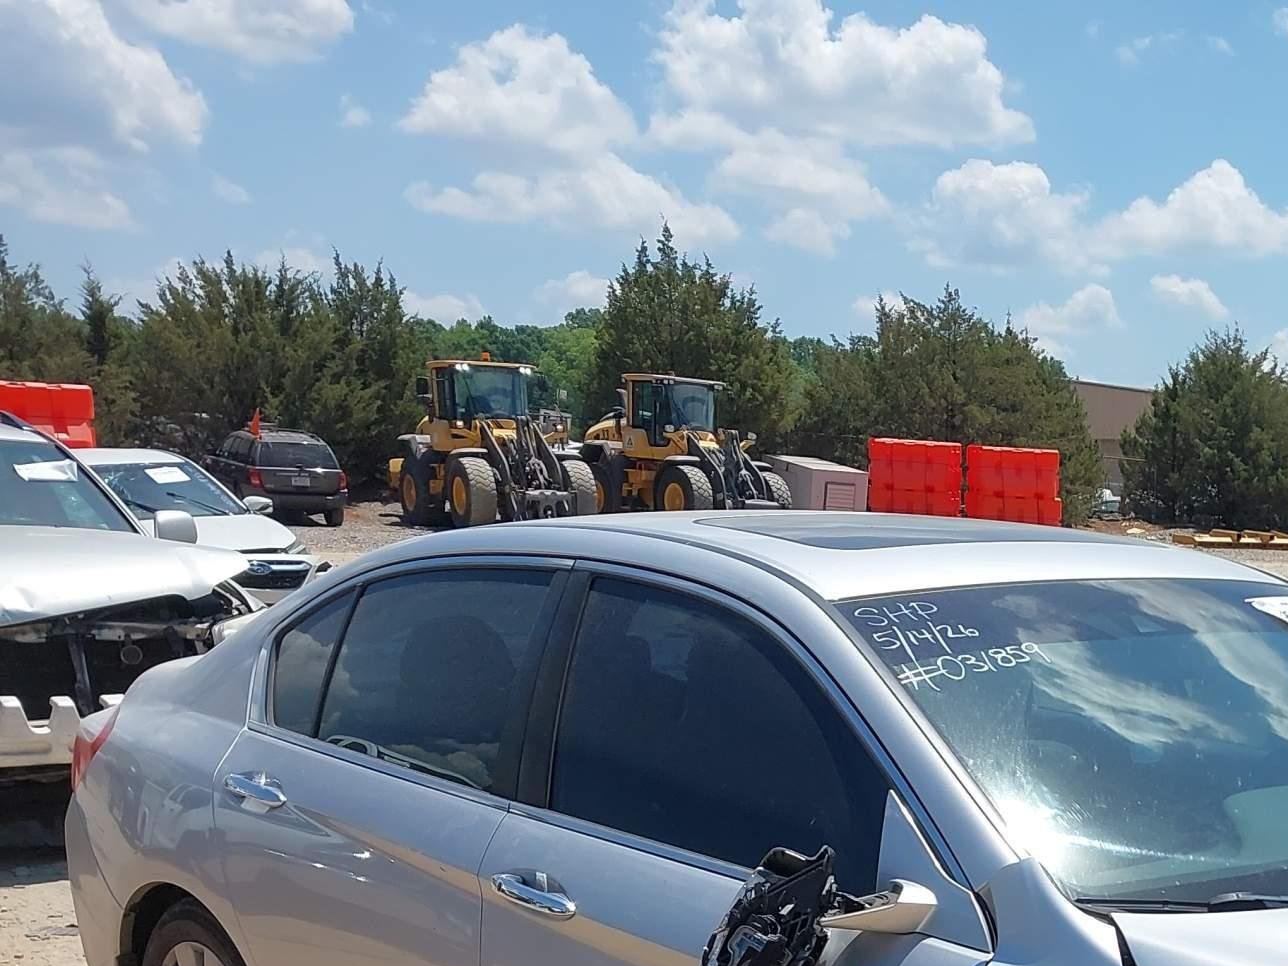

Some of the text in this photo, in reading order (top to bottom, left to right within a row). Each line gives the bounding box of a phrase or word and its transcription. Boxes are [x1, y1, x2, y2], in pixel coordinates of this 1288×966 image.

[854, 602, 938, 626] SHP
[872, 621, 980, 655] 5/14/26
[897, 642, 1051, 691] #031859
